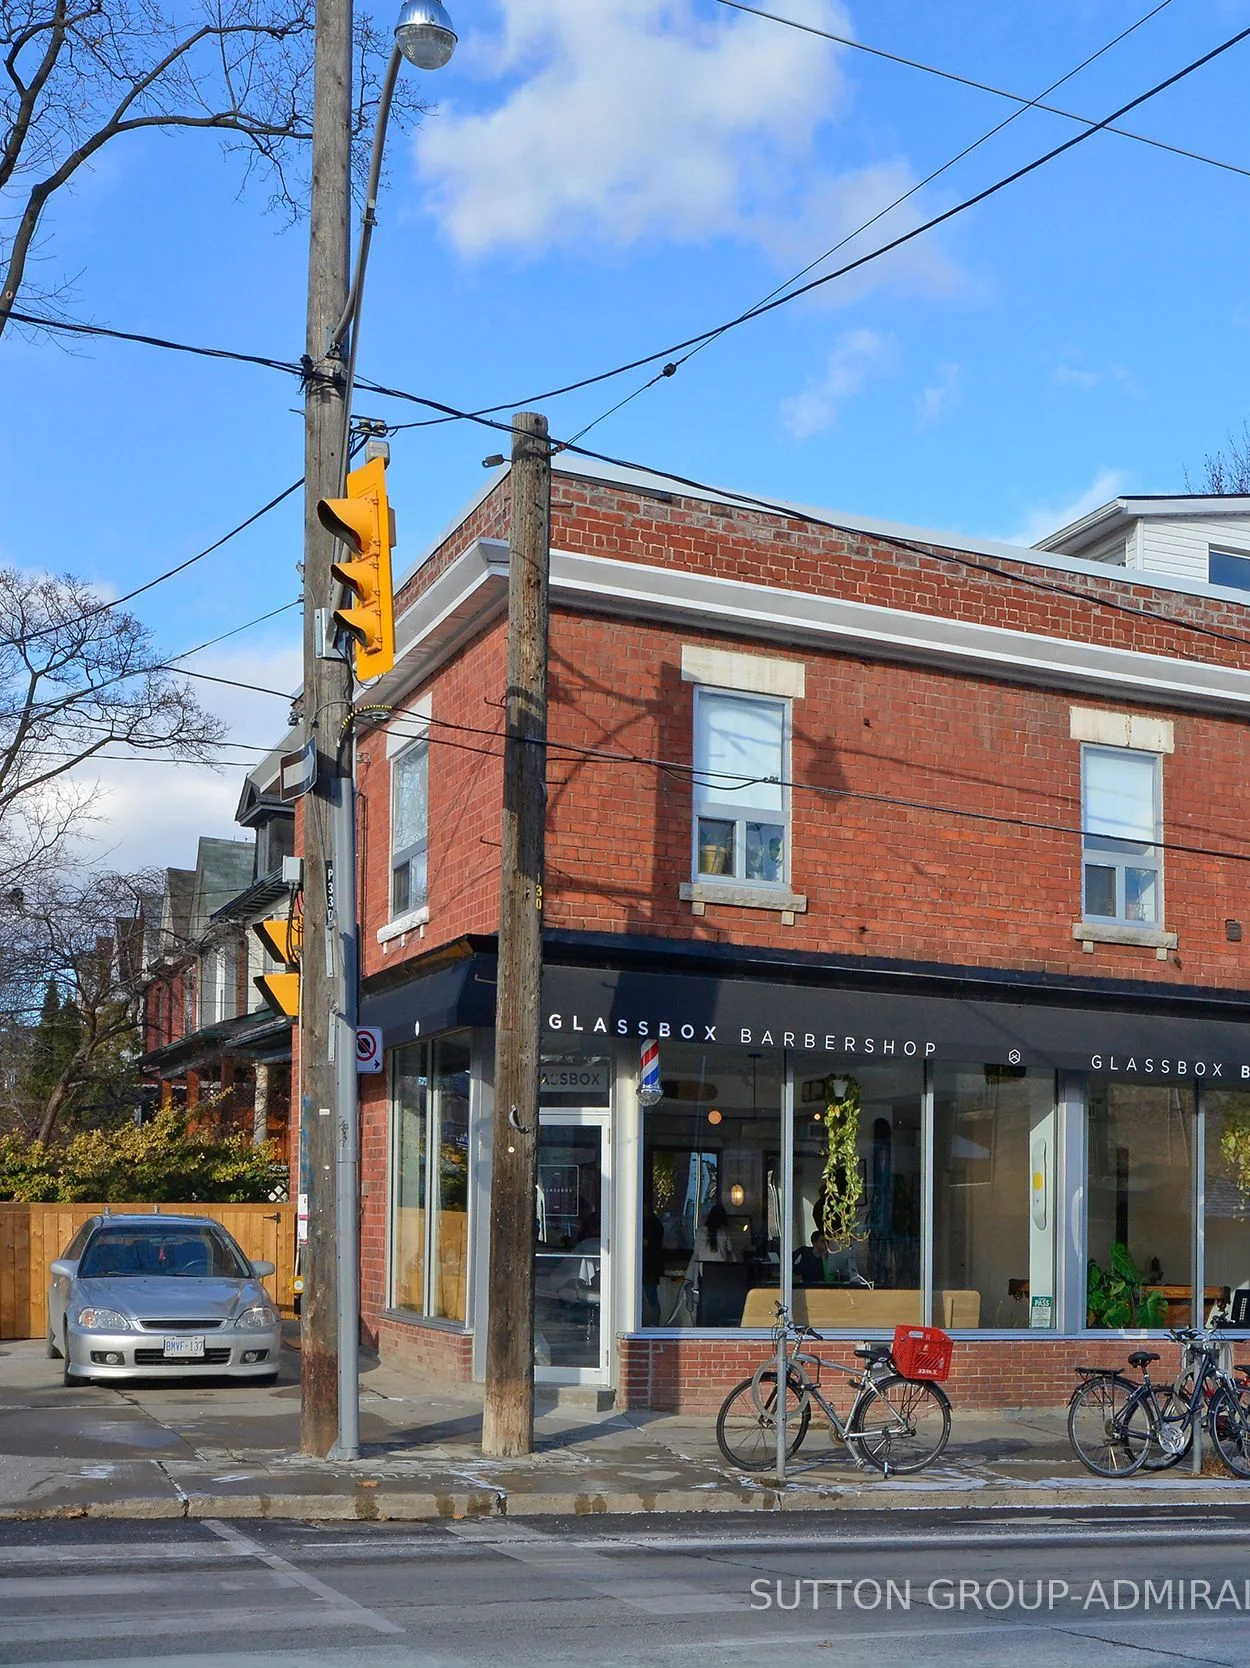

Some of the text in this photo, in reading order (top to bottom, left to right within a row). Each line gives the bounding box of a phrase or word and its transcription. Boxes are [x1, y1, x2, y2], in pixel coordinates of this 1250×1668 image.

[548, 1013, 937, 1057] GLASSBOX BARBERSHOP
[1091, 1054, 1223, 1077] GLASSBOX
[1034, 1299, 1050, 1307] PASS
